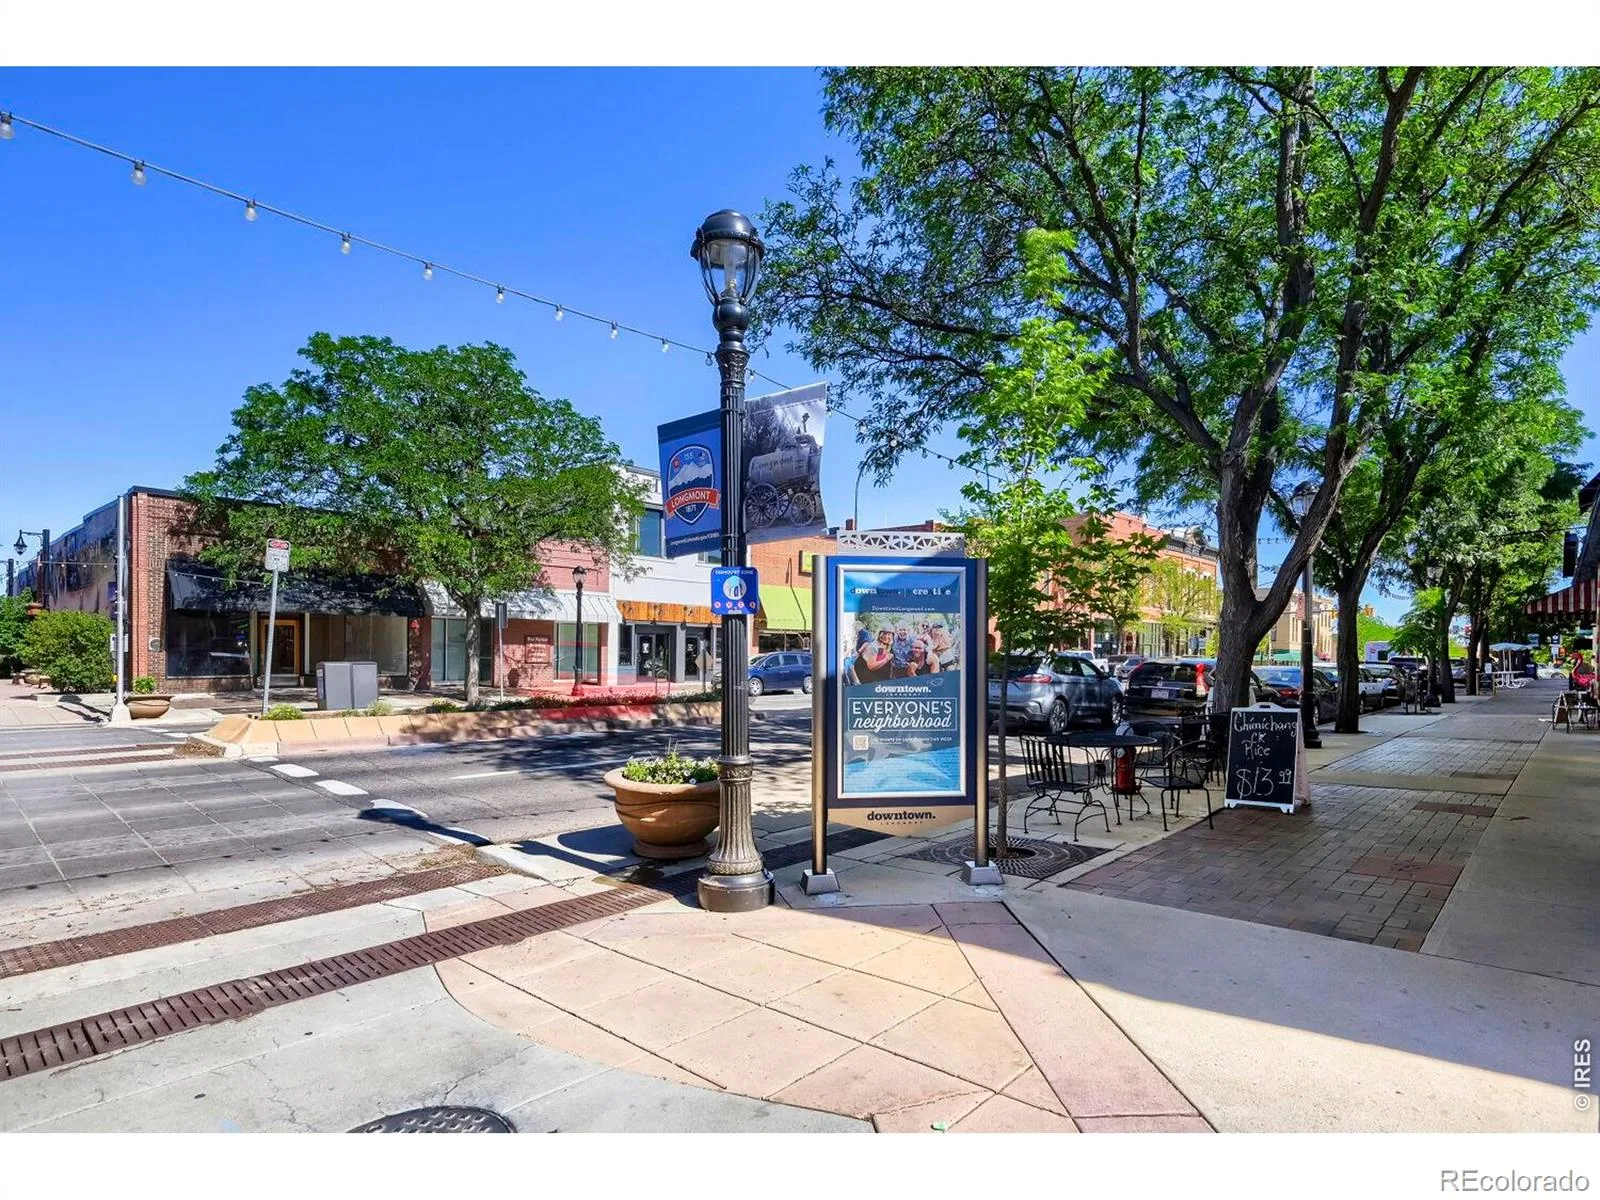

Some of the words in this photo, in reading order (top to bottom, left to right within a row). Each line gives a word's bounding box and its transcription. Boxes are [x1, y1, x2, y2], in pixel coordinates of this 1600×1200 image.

[671, 491, 711, 508] LONGMONT
[912, 587, 952, 596] cretie
[875, 684, 931, 693] downtown.
[853, 701, 953, 715] EVERYONE'S
[853, 714, 953, 733] neighborhood
[1241, 740, 1271, 760] Rice
[866, 810, 937, 821] downtown.
